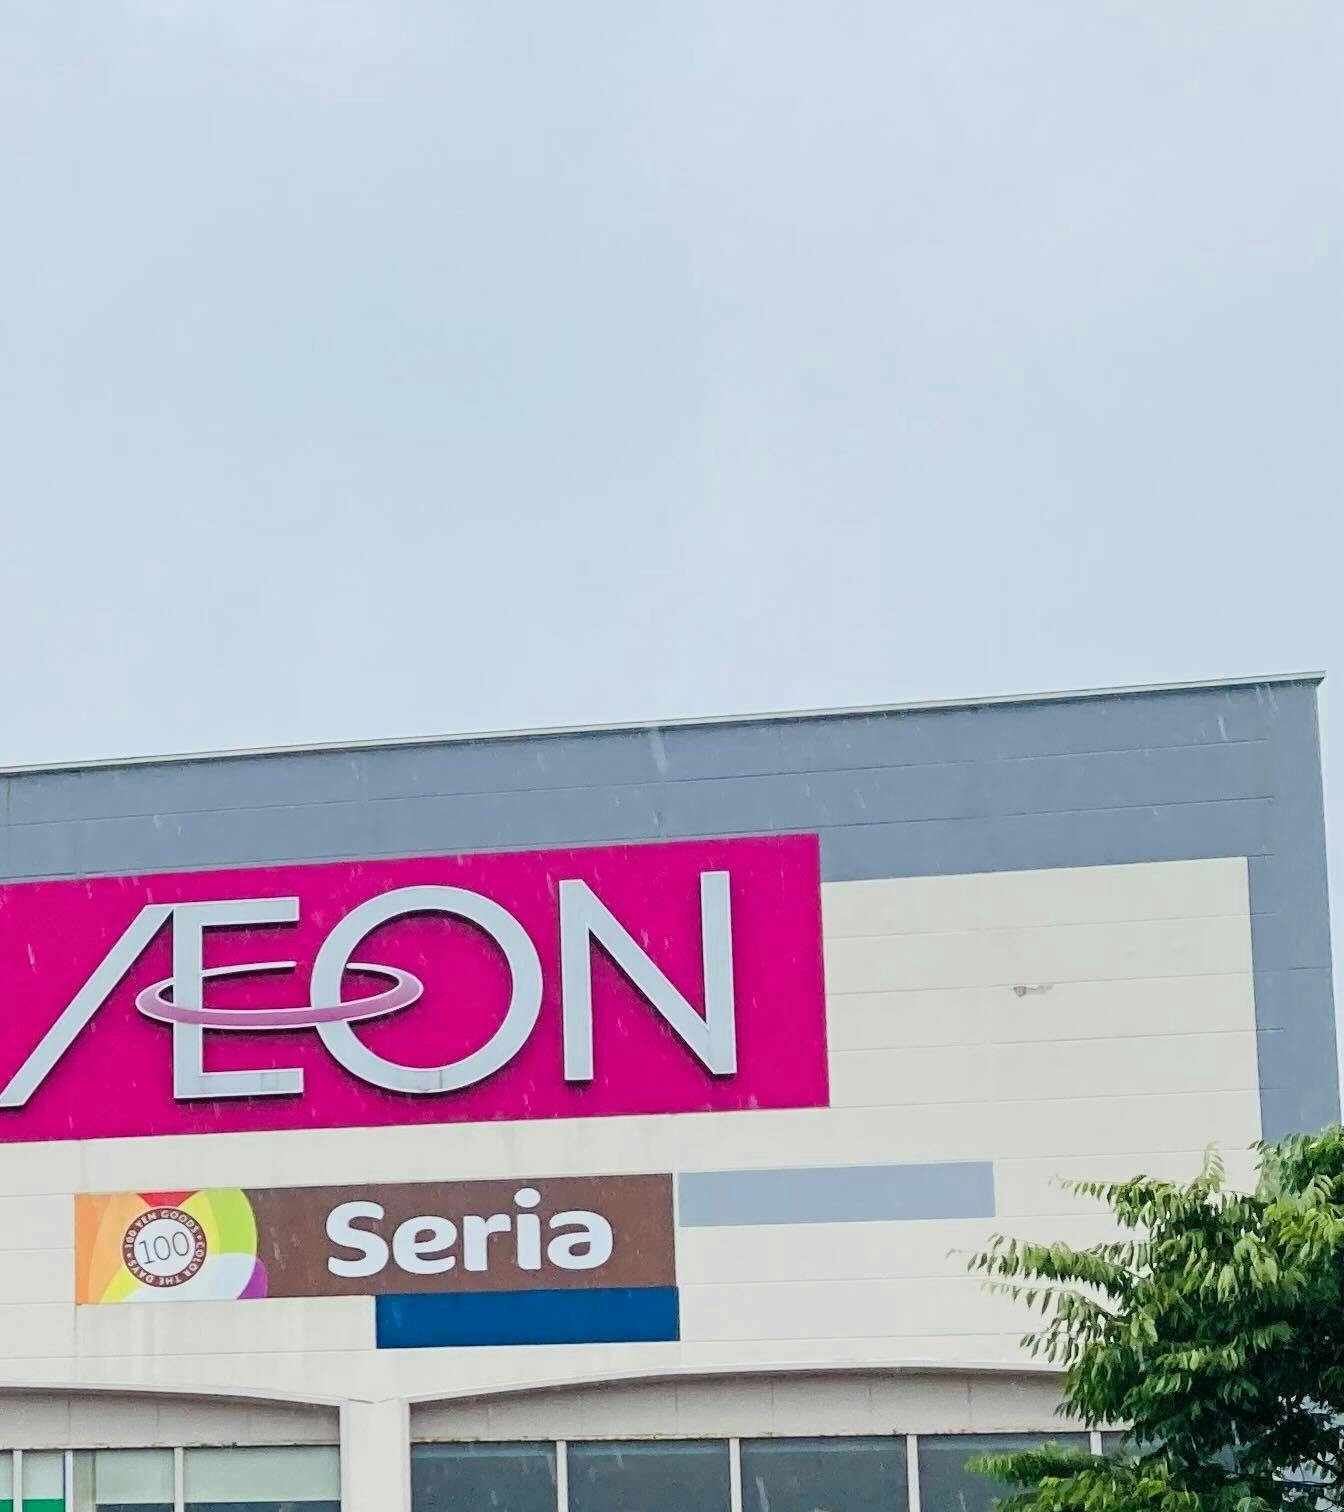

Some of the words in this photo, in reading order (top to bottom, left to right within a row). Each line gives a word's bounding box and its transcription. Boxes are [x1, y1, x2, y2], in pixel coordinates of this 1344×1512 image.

[124, 1229, 137, 1249] 100
[135, 1211, 157, 1228] YEN
[160, 1209, 200, 1234] GOODS
[325, 1188, 614, 1278] Seria
[138, 1230, 191, 1265] 100
[182, 1241, 205, 1277] COLOR
[126, 1260, 154, 1284] DAYS
[159, 1277, 182, 1286] THE
